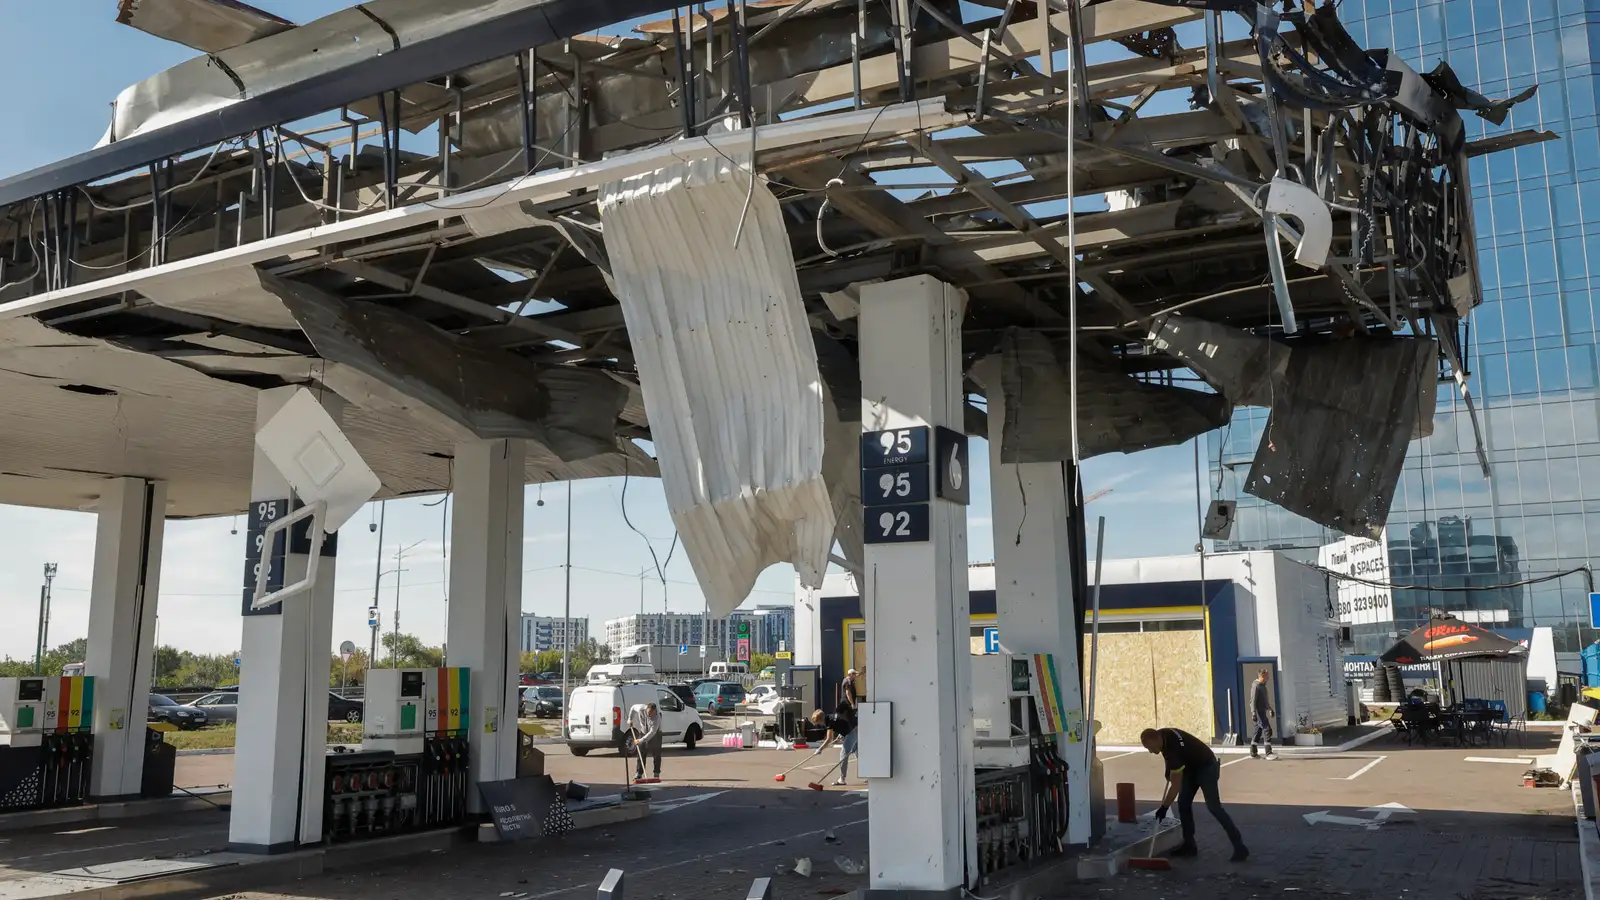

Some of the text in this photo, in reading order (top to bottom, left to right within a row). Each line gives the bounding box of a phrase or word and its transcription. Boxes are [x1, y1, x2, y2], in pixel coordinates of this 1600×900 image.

[880, 429, 912, 455] 95
[883, 456, 908, 465] ENERGY
[949, 442, 963, 490] 6
[879, 472, 911, 498] 95
[258, 501, 276, 520] 95
[879, 511, 911, 536] 92
[428, 709, 437, 718] 95
[450, 708, 459, 716] 92
